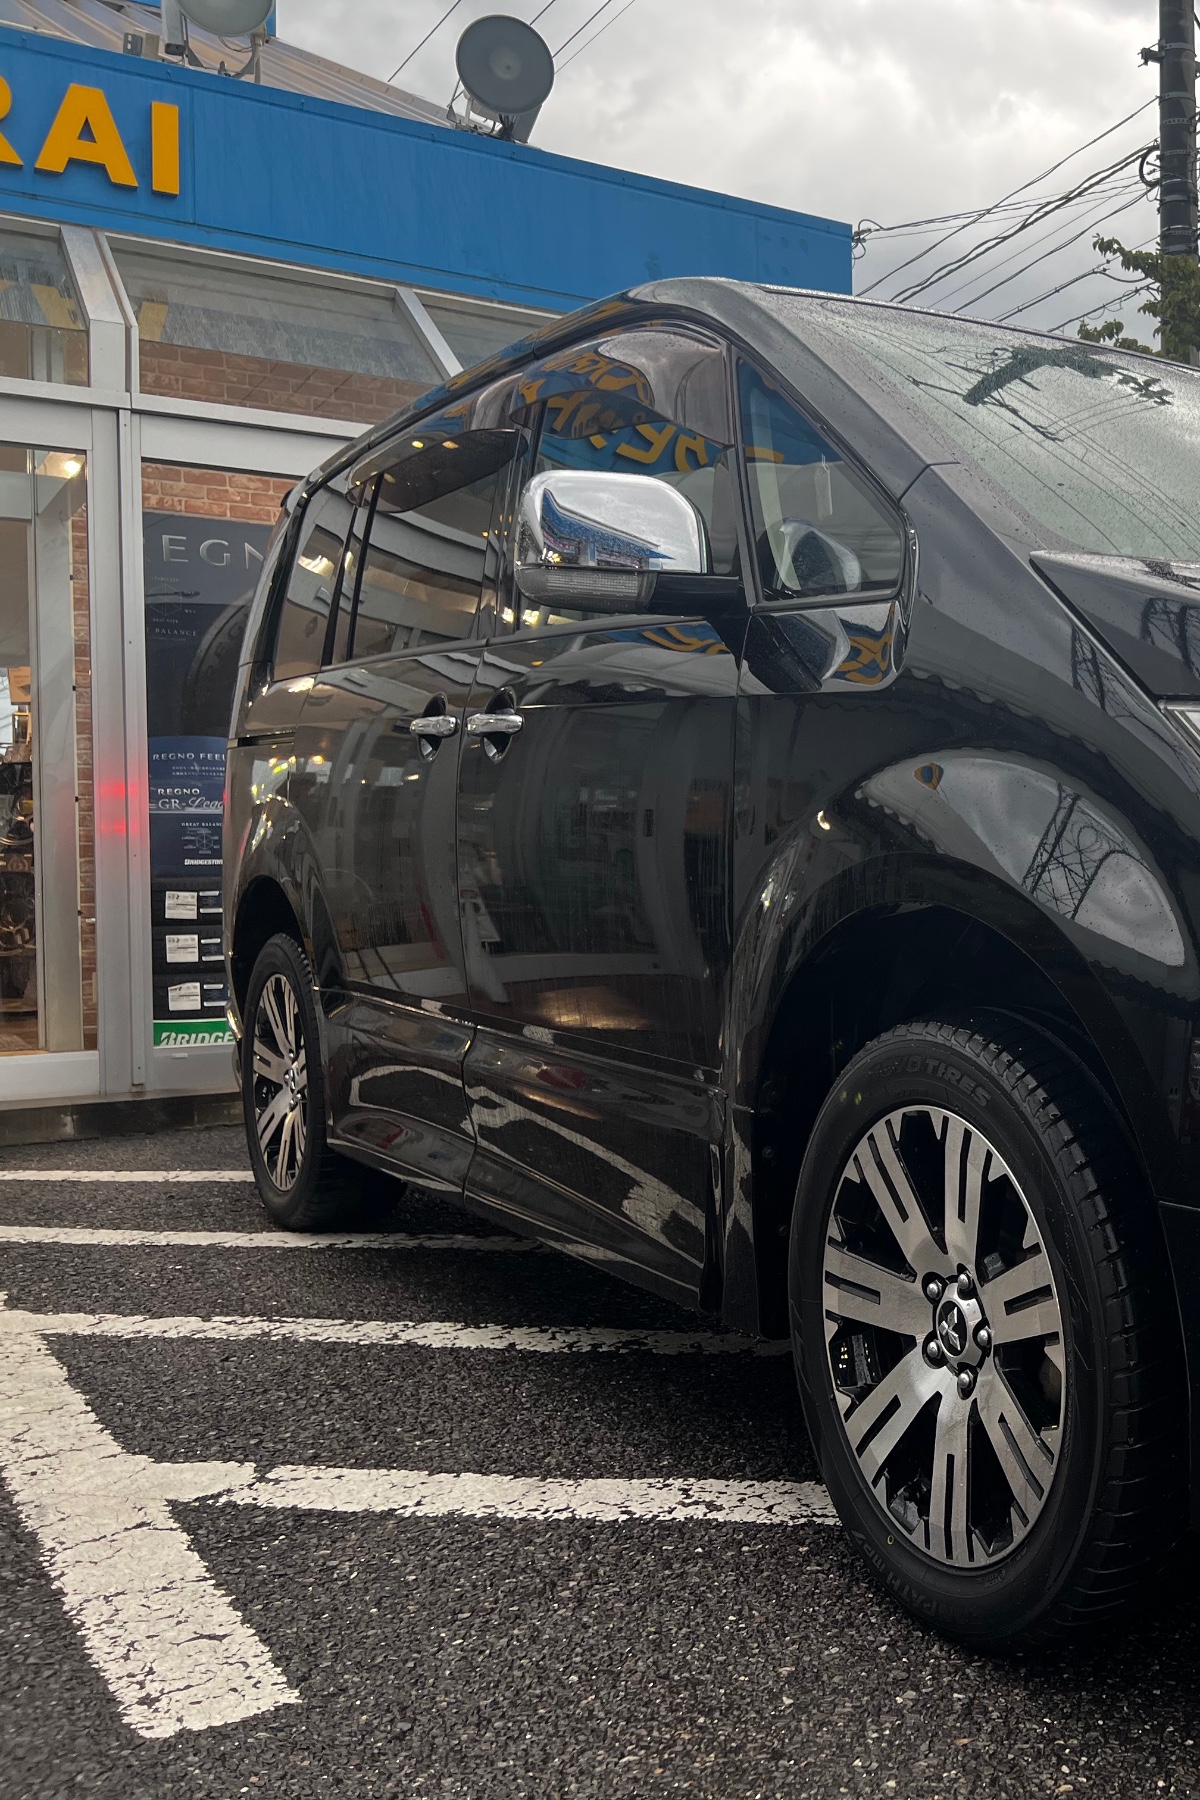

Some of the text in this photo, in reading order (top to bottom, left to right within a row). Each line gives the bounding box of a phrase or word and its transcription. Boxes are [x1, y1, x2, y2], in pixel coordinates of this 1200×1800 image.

[152, 752, 195, 761] REGNO
[157, 787, 201, 796] REGNO
[925, 1057, 992, 1107] TIRES
